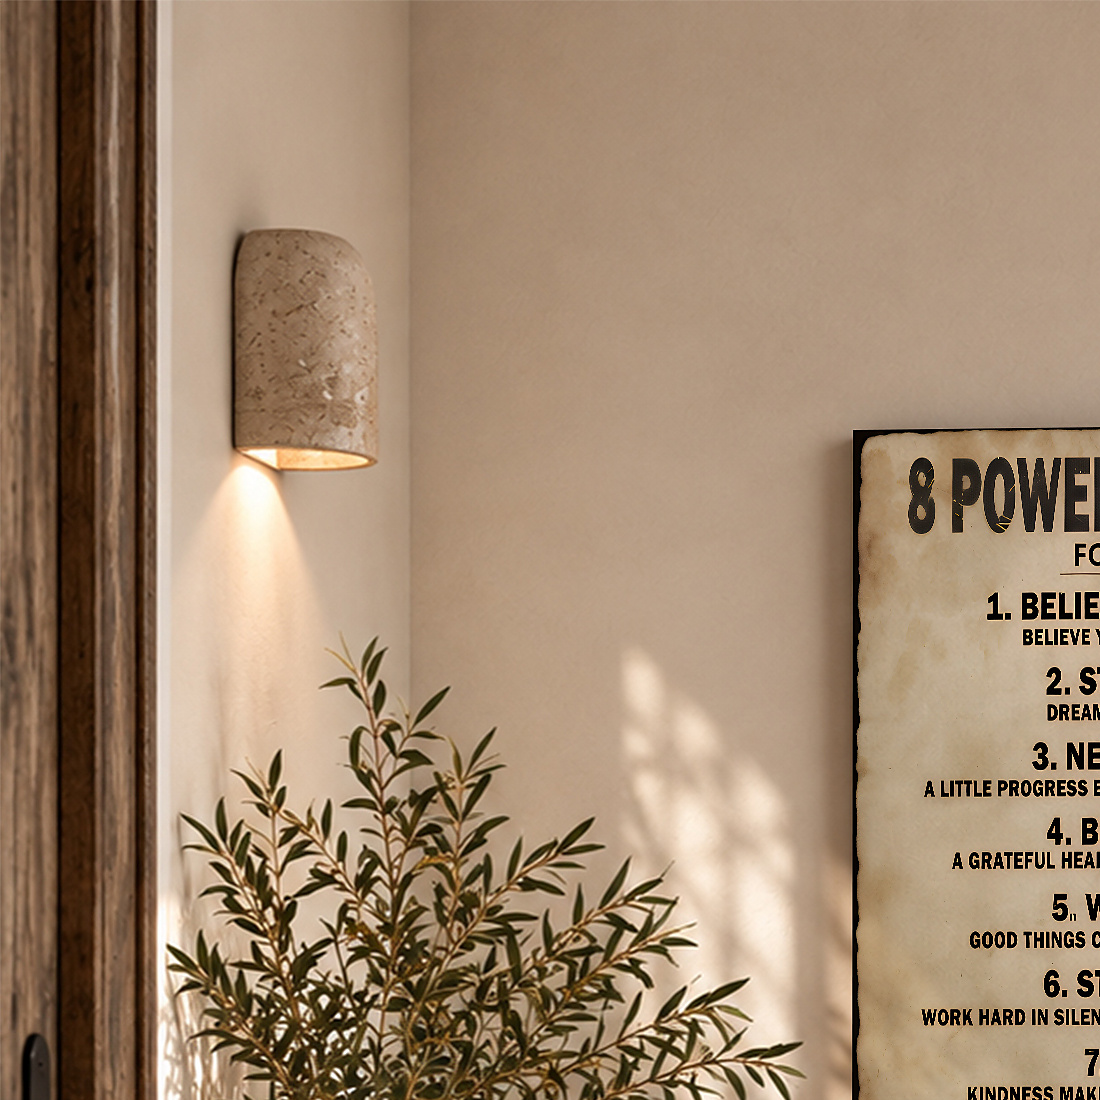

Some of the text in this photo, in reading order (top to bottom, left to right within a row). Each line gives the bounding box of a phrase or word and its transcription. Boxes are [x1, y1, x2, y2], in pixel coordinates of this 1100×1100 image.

[907, 457, 936, 535] 8
[986, 591, 1012, 621] 1.
[1022, 628, 1091, 646] BELIEVE
[1045, 666, 1071, 696] 2.
[1031, 741, 1058, 771] 3.
[923, 780, 936, 798] A
[940, 779, 993, 798] LITTLE
[997, 779, 1089, 798] PROGRESS
[1046, 817, 1072, 846] 4.
[951, 851, 964, 870] A
[968, 851, 1056, 870] GRATEFUL
[969, 930, 1018, 950] GOOD
[1022, 930, 1086, 949] THINGS
[1043, 969, 1068, 998] 6.
[921, 1008, 974, 1027] WORK
[978, 1008, 1026, 1026] HARD
[1031, 1008, 1049, 1026] IN
